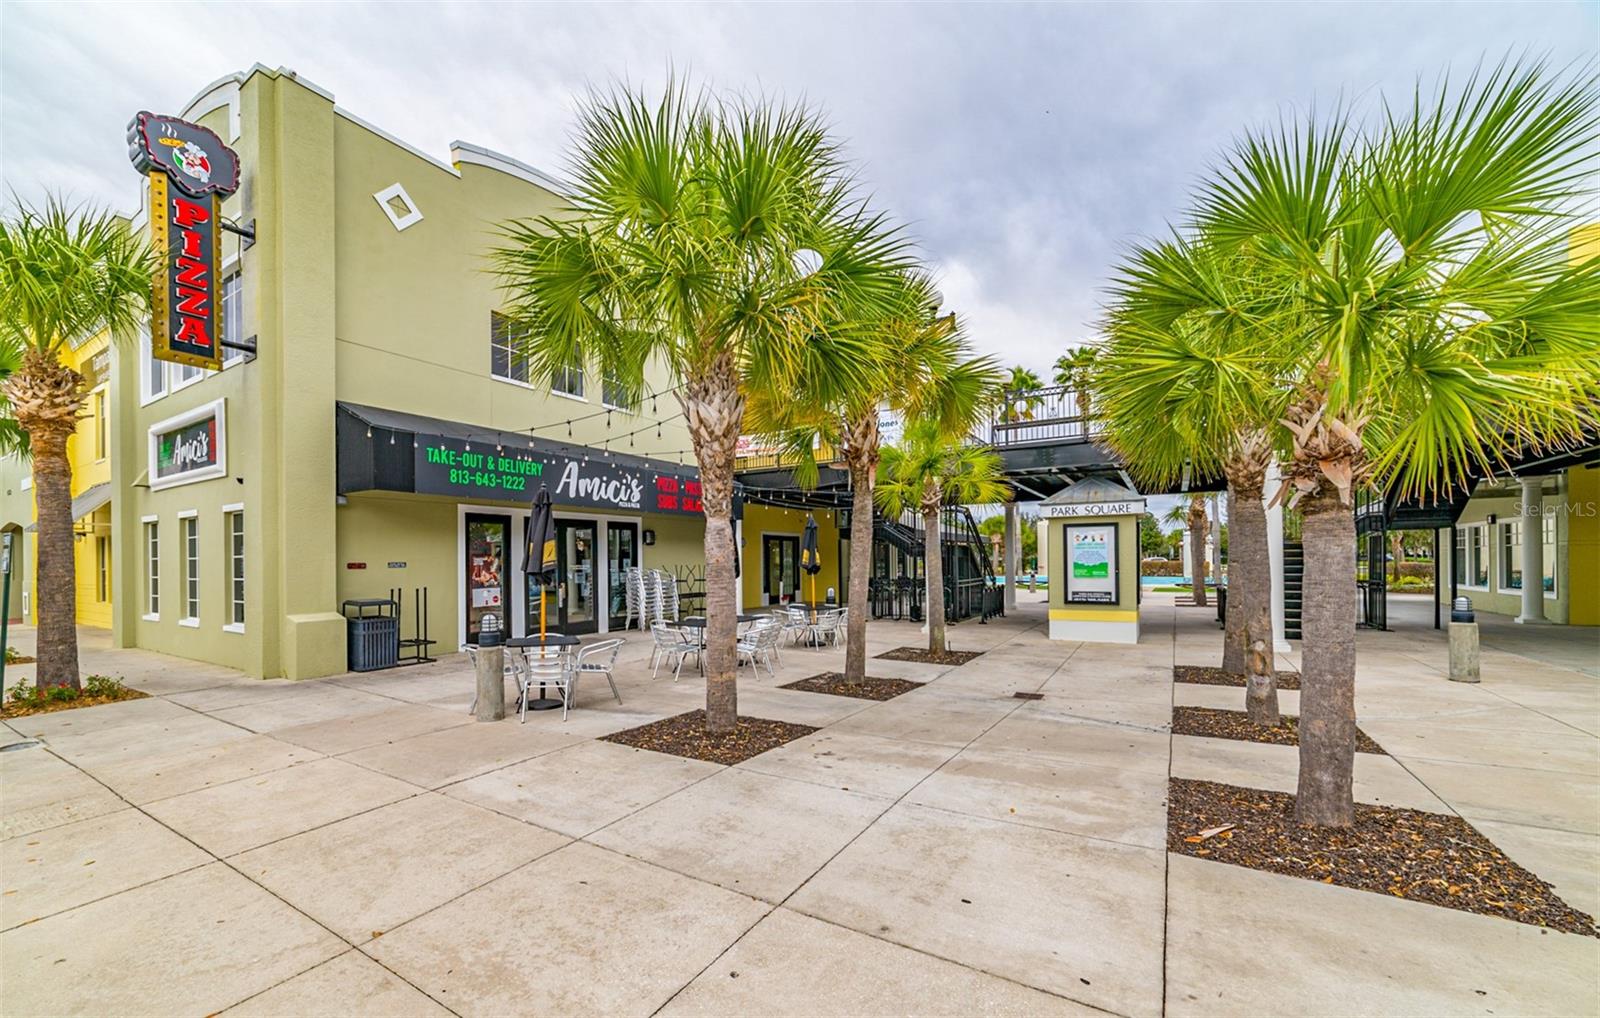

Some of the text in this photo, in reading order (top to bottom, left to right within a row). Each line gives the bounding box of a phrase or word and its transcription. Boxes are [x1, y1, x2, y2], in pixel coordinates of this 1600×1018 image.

[173, 198, 211, 347] PIZZA
[427, 447, 543, 476] TAKE-OUT & DELIVERY
[449, 469, 525, 491] 813-643-1222
[555, 461, 644, 504] Amici's
[1051, 503, 1131, 516] PARK SQUARE
